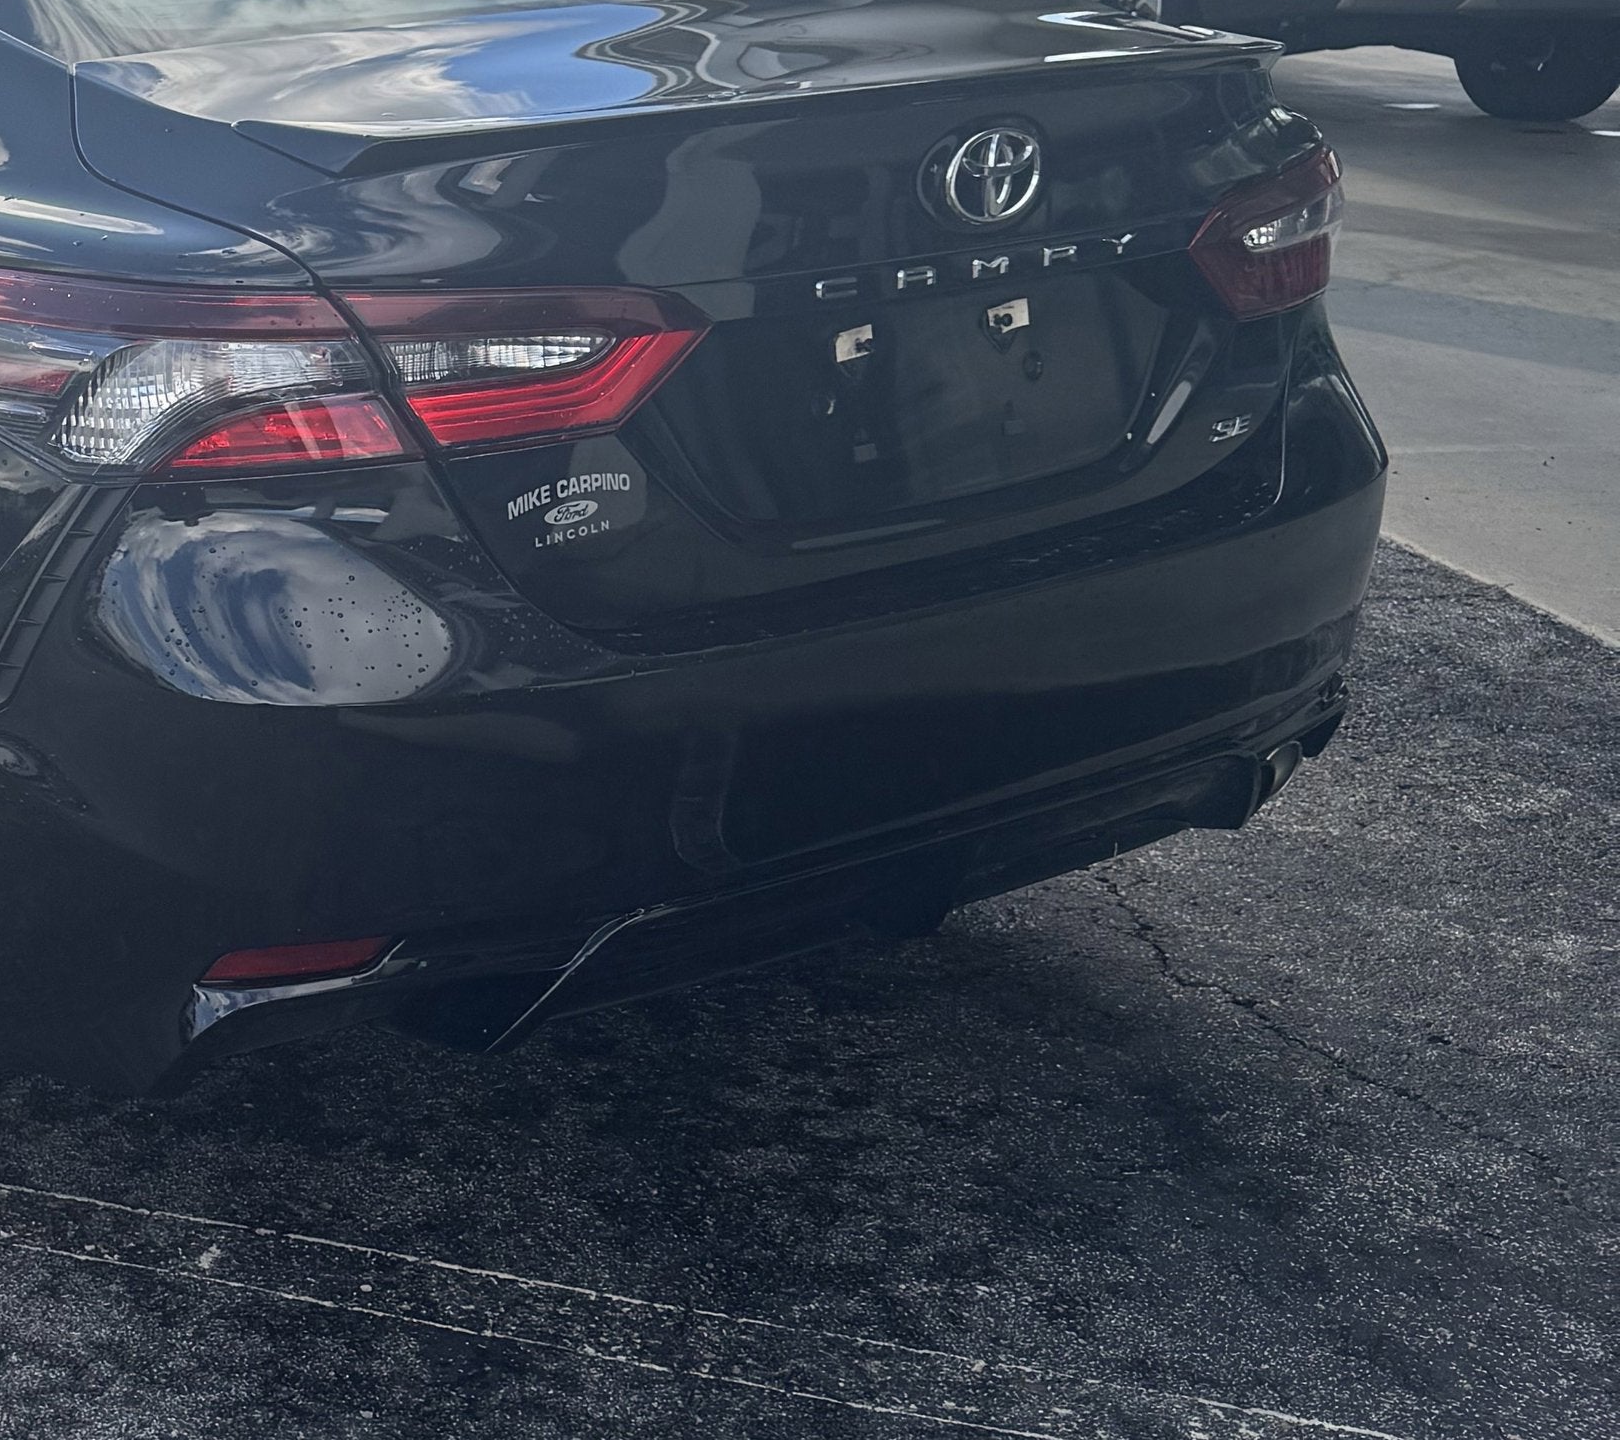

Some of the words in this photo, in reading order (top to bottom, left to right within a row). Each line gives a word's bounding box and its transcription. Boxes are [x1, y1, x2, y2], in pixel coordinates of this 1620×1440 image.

[816, 233, 1137, 300] CAMRY
[1209, 414, 1252, 442] SE
[507, 484, 551, 520] MIKE
[556, 473, 630, 498] CARPINO
[552, 502, 591, 523] Ford
[535, 520, 609, 548] LINCOLN
